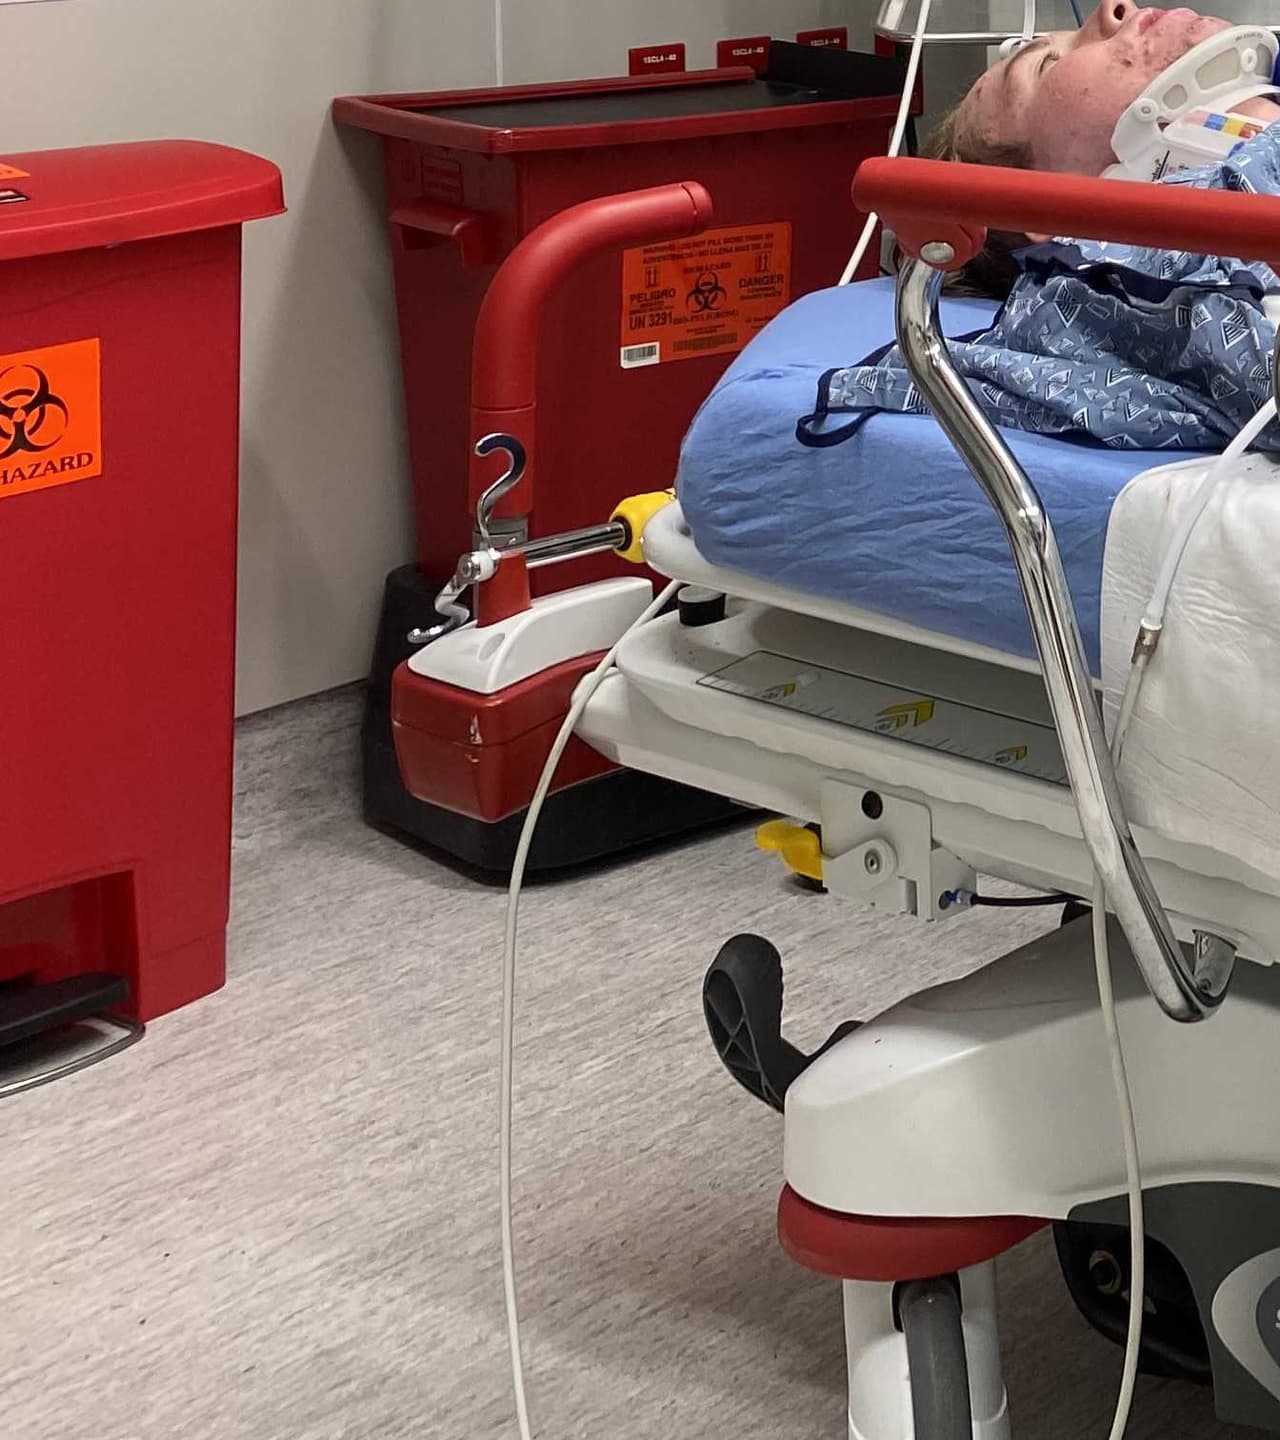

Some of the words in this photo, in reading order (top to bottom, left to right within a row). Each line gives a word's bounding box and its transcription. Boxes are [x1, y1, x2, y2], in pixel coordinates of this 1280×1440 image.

[739, 274, 784, 288] DANGER
[629, 288, 676, 303] PELIGRO
[629, 315, 646, 330] UN
[649, 311, 673, 328] 3291
